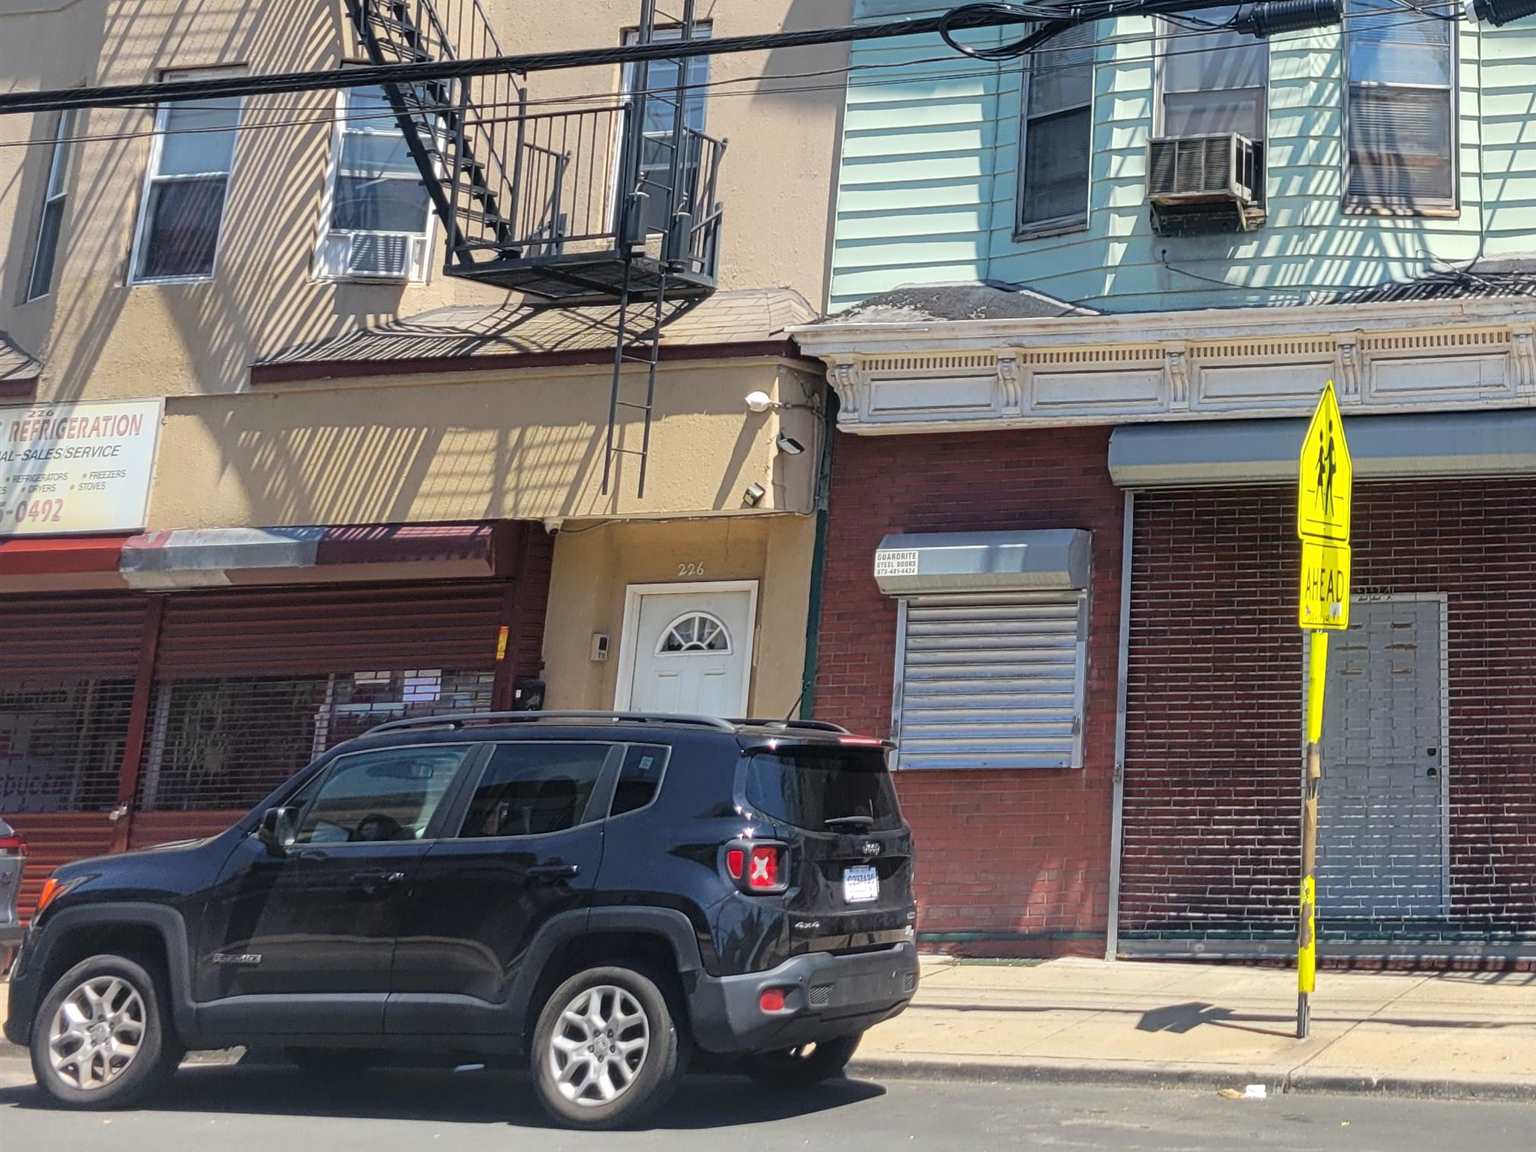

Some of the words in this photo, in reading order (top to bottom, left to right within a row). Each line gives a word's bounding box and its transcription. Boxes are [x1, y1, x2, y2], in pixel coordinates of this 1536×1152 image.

[28, 409, 55, 418] 226
[8, 414, 144, 442] REFRIGERATION
[64, 444, 122, 459] SERVICE
[678, 561, 704, 576] 226
[1305, 567, 1345, 603] AHEAD
